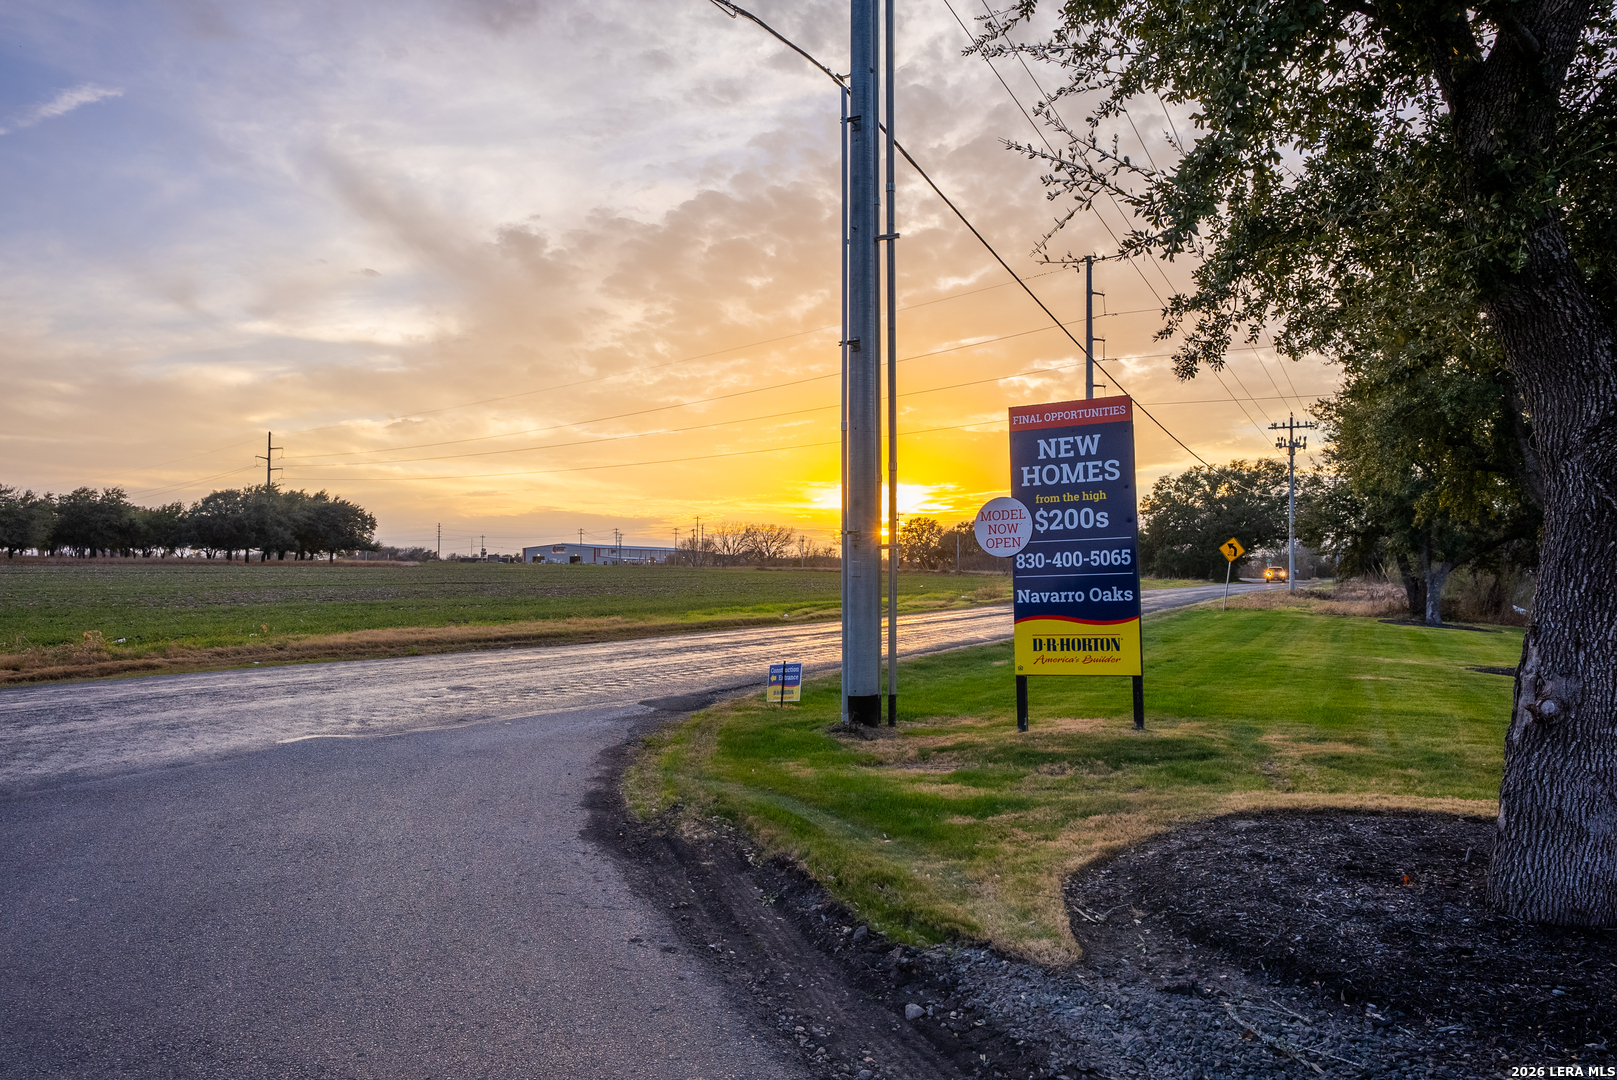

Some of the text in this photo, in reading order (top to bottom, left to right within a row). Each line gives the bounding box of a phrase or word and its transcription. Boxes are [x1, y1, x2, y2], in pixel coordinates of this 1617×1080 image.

[1012, 405, 1126, 425] FINAL OPPORTUNITIES
[1037, 433, 1101, 460] NEW
[1021, 459, 1121, 487] HOMES
[1035, 490, 1107, 504] from the high
[980, 509, 1027, 522] MODEL
[1034, 507, 1110, 534] $200s
[988, 523, 1019, 535] NOW
[985, 537, 1021, 549] OPEN
[1016, 549, 1132, 569] 830-400-5065
[1017, 586, 1134, 604] Navarro Oaks
[1033, 654, 1122, 665] America's Builder
